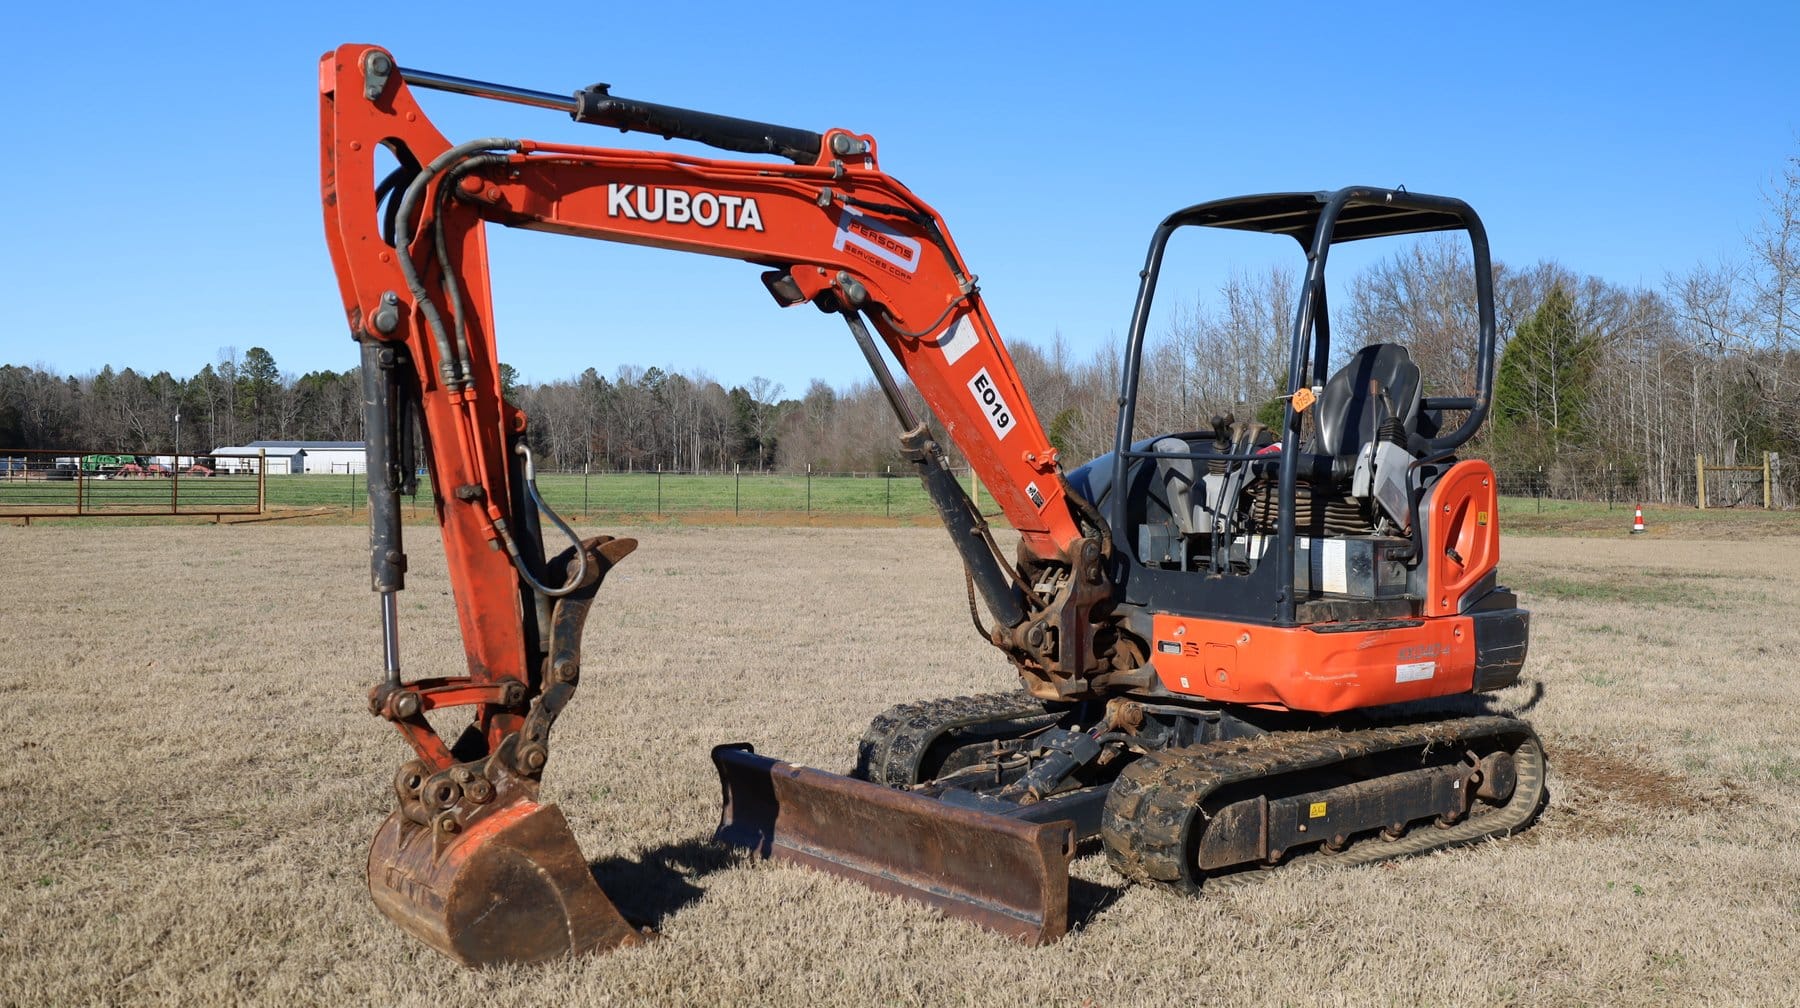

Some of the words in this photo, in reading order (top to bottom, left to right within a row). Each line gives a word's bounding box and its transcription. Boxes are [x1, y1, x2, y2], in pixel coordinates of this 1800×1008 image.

[607, 183, 765, 232] KUBOTA
[845, 244, 887, 269] SERVICES
[850, 223, 912, 259] PERSONS
